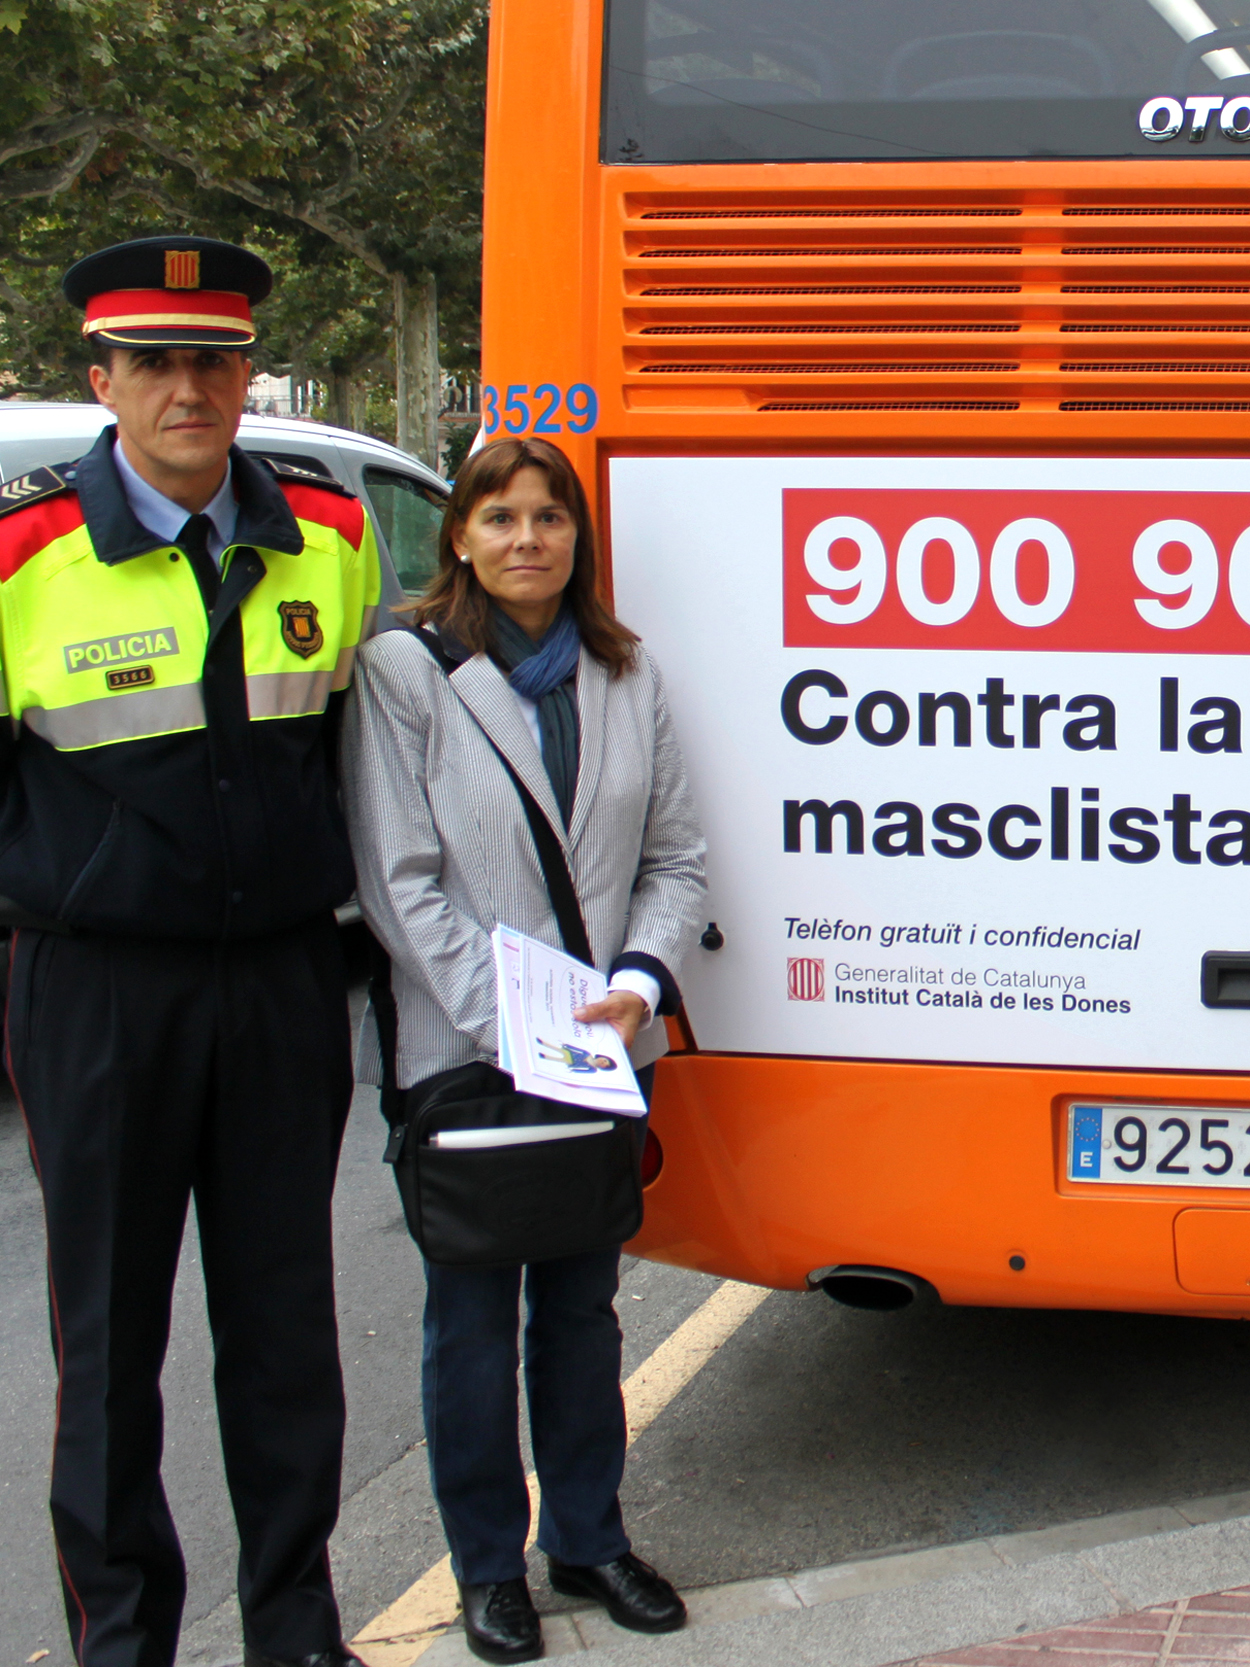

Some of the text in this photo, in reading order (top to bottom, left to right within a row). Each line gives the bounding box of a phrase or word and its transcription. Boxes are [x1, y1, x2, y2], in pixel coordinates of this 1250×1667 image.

[484, 383, 598, 434] 3529
[803, 516, 1074, 627] 900
[68, 632, 172, 668] POLICIA
[112, 670, 147, 685] 3566
[780, 669, 1117, 752] Contra
[1160, 677, 1243, 754] la
[784, 917, 1141, 951] Telèfon gratuït i confidencial
[835, 963, 1086, 993] Generalitat de Catalunya
[835, 986, 1131, 1014] Institut Català de les Dones
[1080, 1152, 1093, 1168] E
